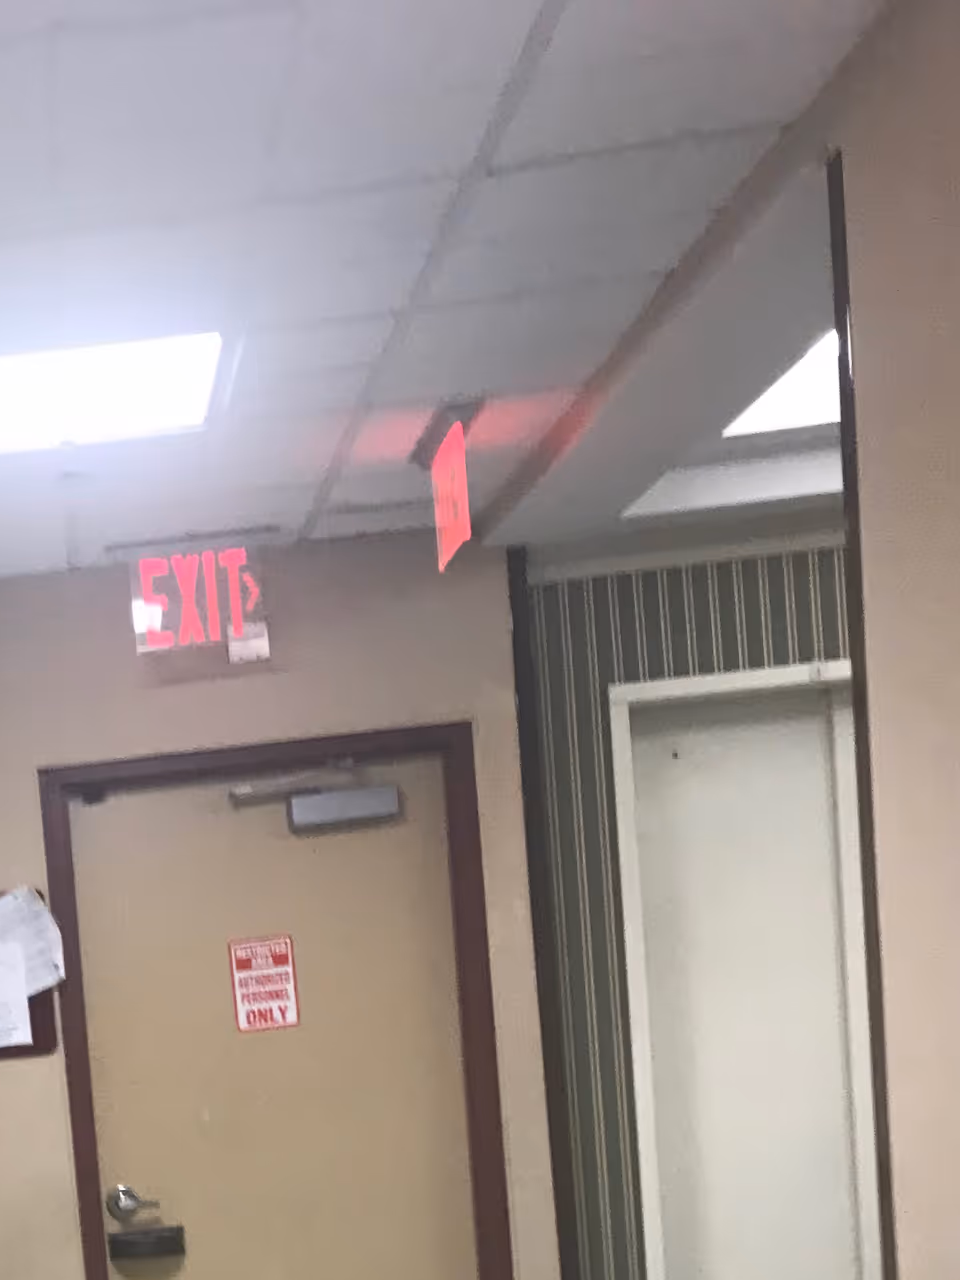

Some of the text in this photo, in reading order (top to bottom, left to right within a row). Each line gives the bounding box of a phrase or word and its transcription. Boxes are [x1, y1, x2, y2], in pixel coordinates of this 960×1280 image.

[139, 547, 247, 648] EXIT
[238, 972, 291, 988] AUTHORIZED
[241, 989, 290, 1005] PERSONNEL
[246, 1004, 289, 1026] ONLY
